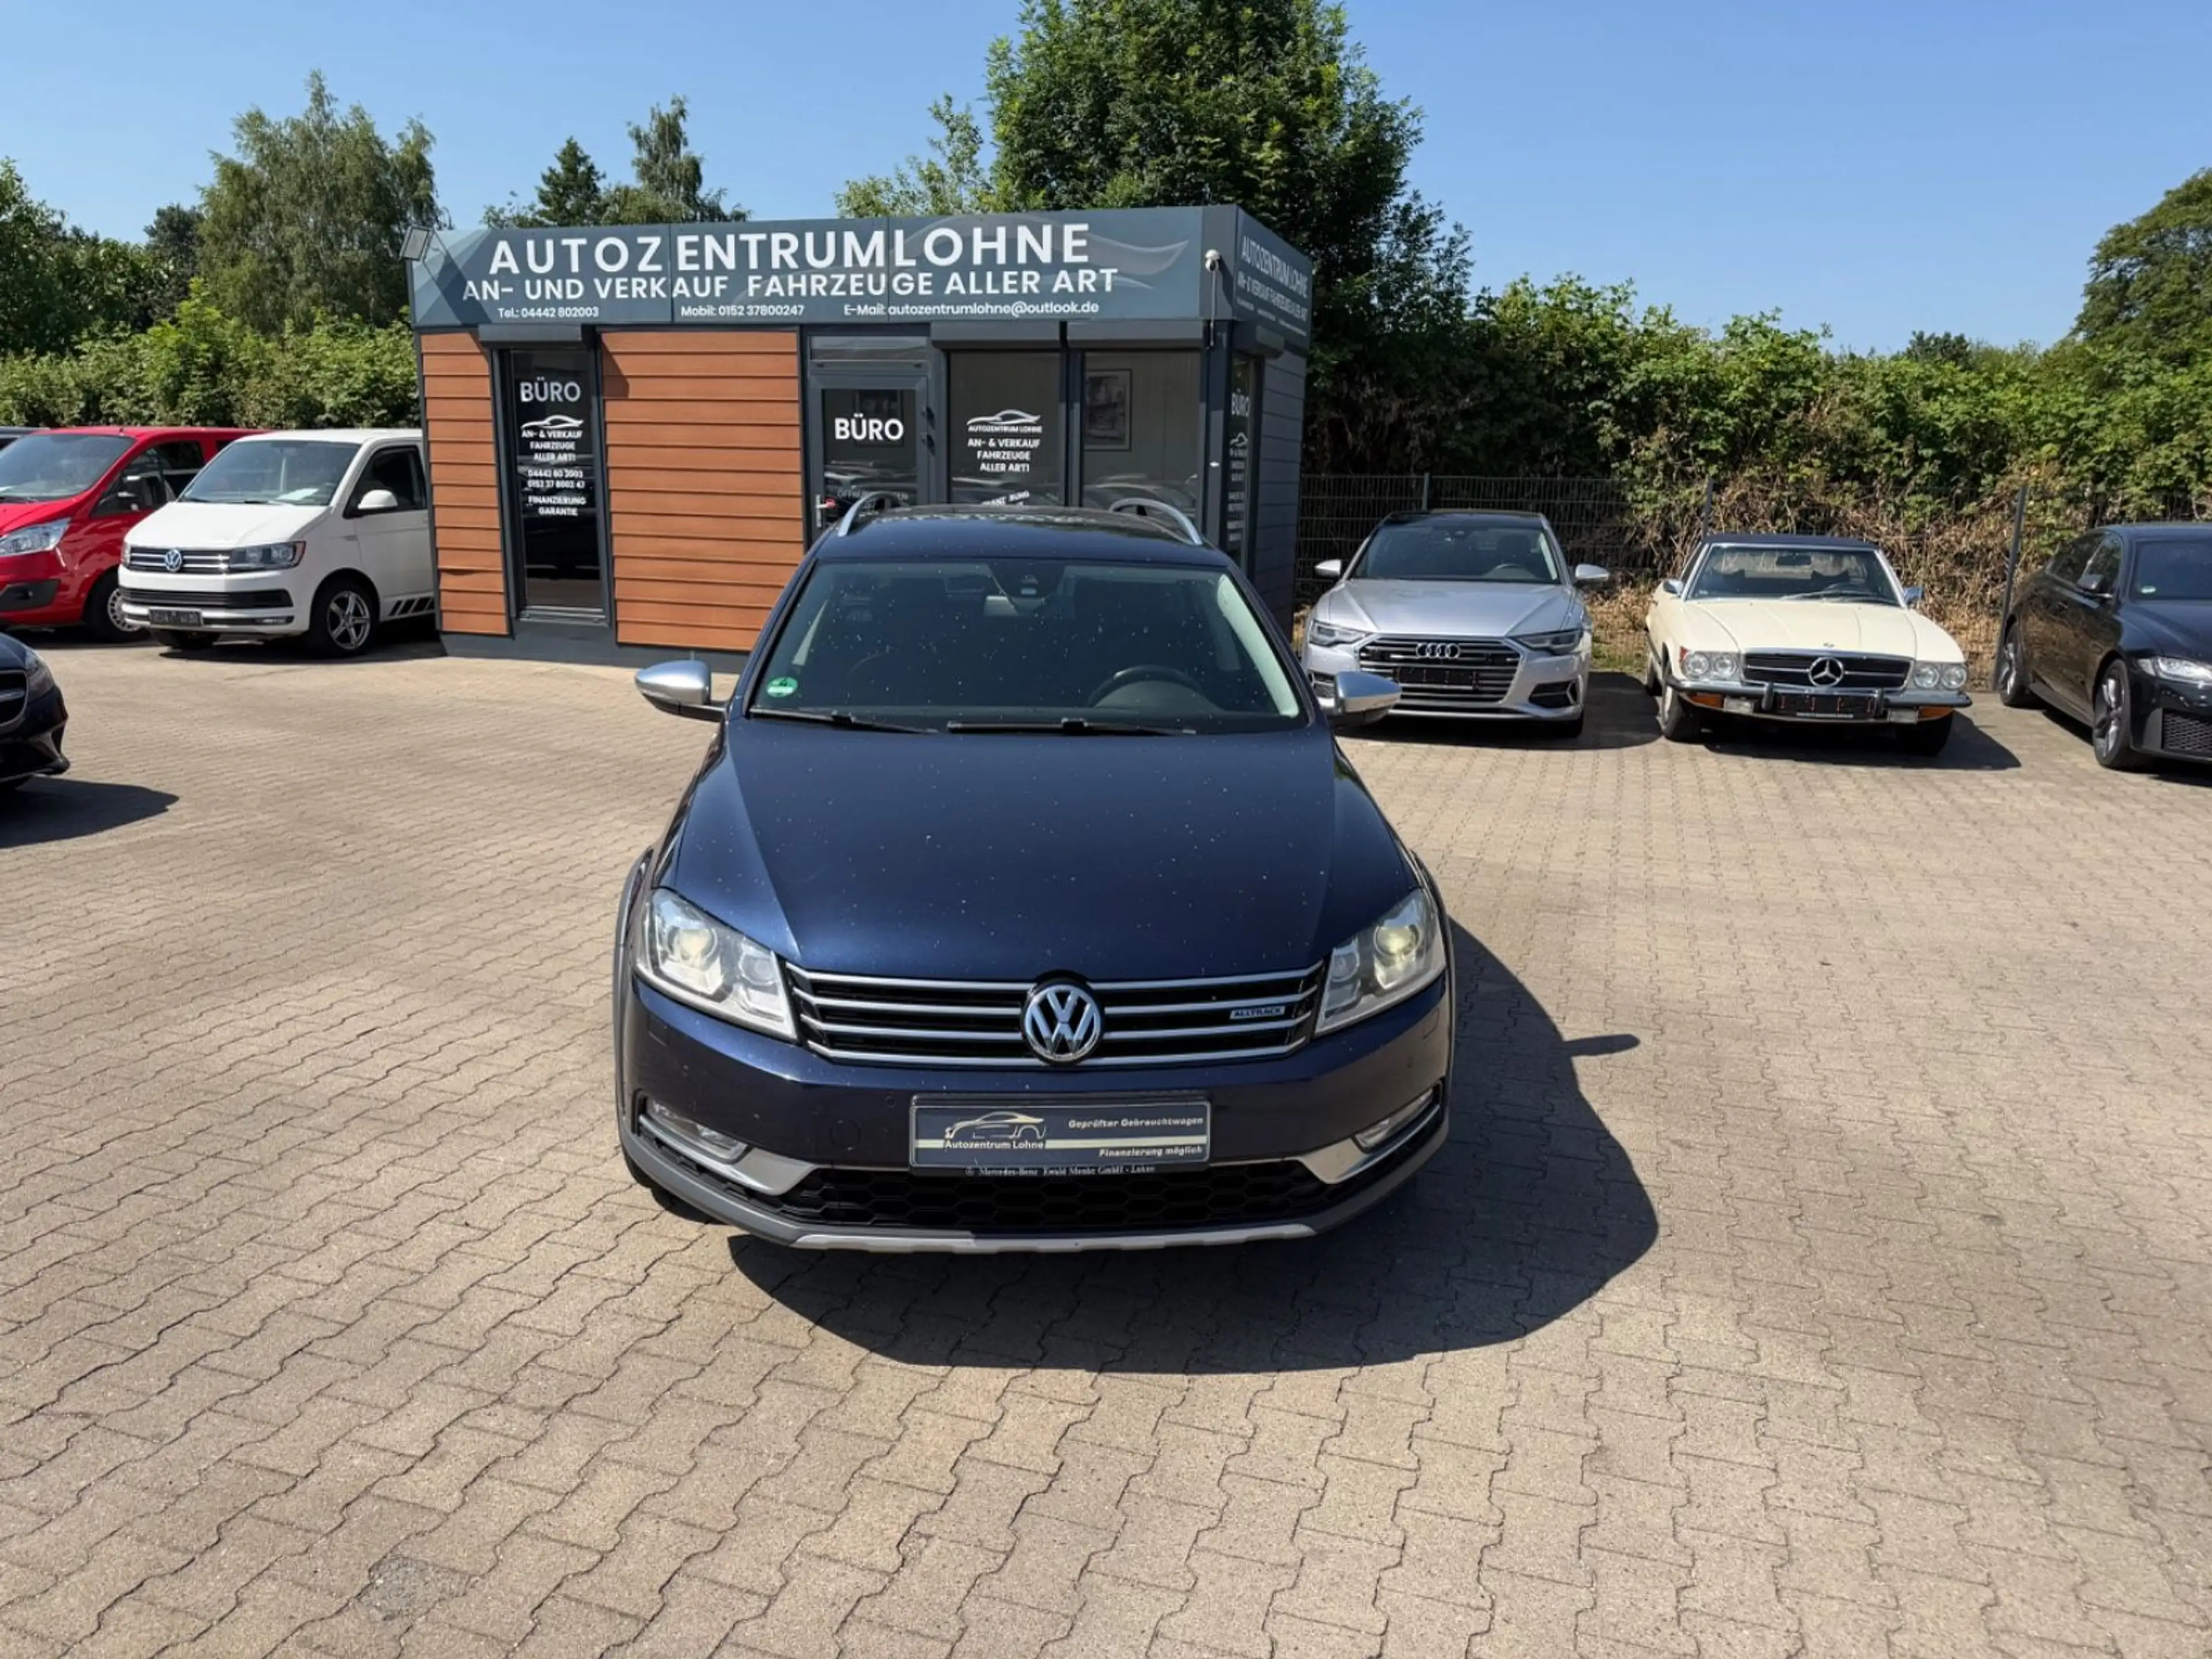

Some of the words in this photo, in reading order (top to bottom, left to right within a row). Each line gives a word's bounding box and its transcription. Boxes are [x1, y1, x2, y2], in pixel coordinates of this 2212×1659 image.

[463, 278, 514, 301] AN-
[525, 278, 584, 300] UND
[594, 275, 729, 300] VERKAUF
[748, 271, 934, 297] FAHRZEUGE
[945, 270, 1041, 296] ALLER
[1052, 268, 1118, 293] ART
[521, 306, 556, 318] 04442
[557, 306, 600, 317] 802003
[681, 305, 717, 316] Mobil:
[718, 305, 745, 316] 0152
[746, 304, 805, 316] 37800247
[888, 300, 1100, 317] autozentrumlohne@outlook.de
[520, 376, 581, 402] BÜRO
[835, 412, 904, 441] BÜRO
[968, 438, 986, 447] AN-
[988, 438, 997, 447] &
[997, 438, 1041, 448] VERKAUF
[977, 450, 1031, 461] FAHRZEUGE
[980, 463, 1006, 472] ALLER
[945, 1139, 1010, 1149] Autozentrum
[1013, 1138, 1044, 1149] Lohne
